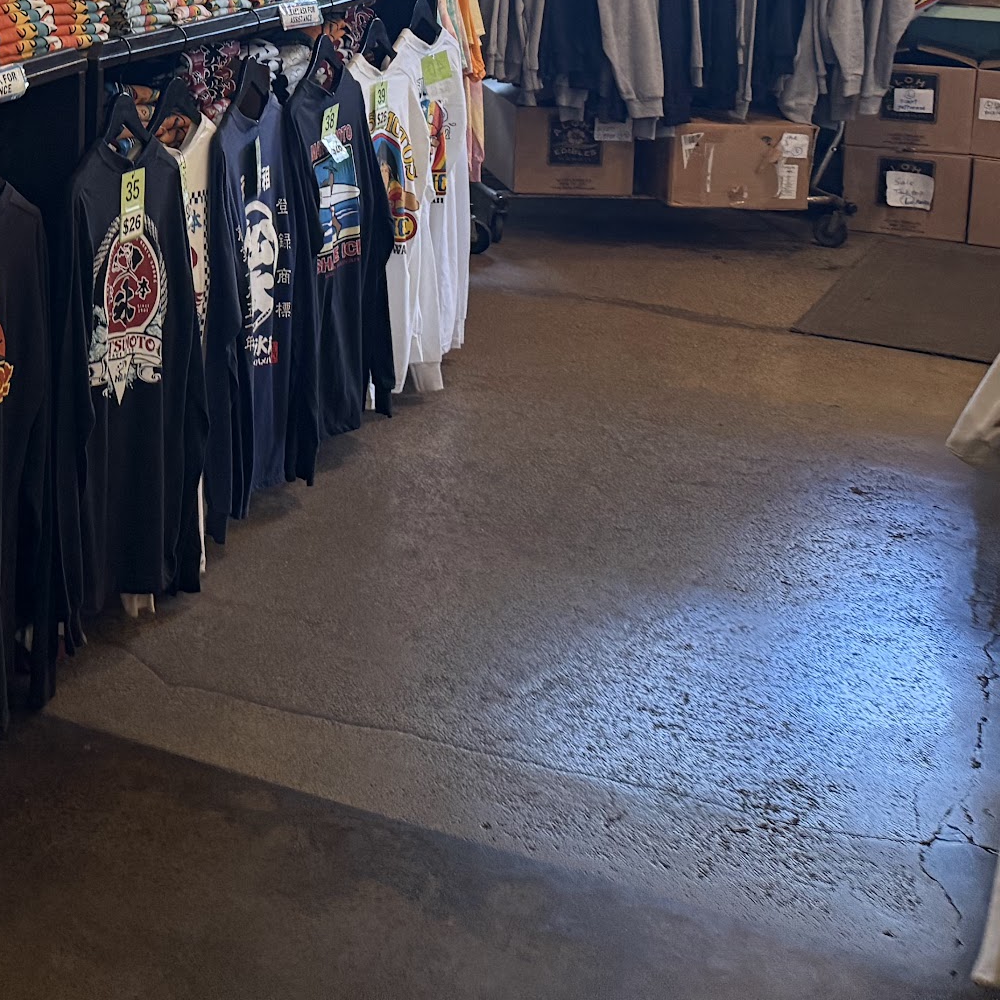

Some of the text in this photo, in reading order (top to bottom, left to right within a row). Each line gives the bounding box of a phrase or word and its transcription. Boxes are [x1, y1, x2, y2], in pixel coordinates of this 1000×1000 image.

[3, 72, 18, 82] FOR
[377, 87, 386, 105] 39
[324, 114, 334, 130] 38
[377, 111, 387, 128] $26
[125, 178, 140, 203] 35
[123, 214, 141, 236] $26
